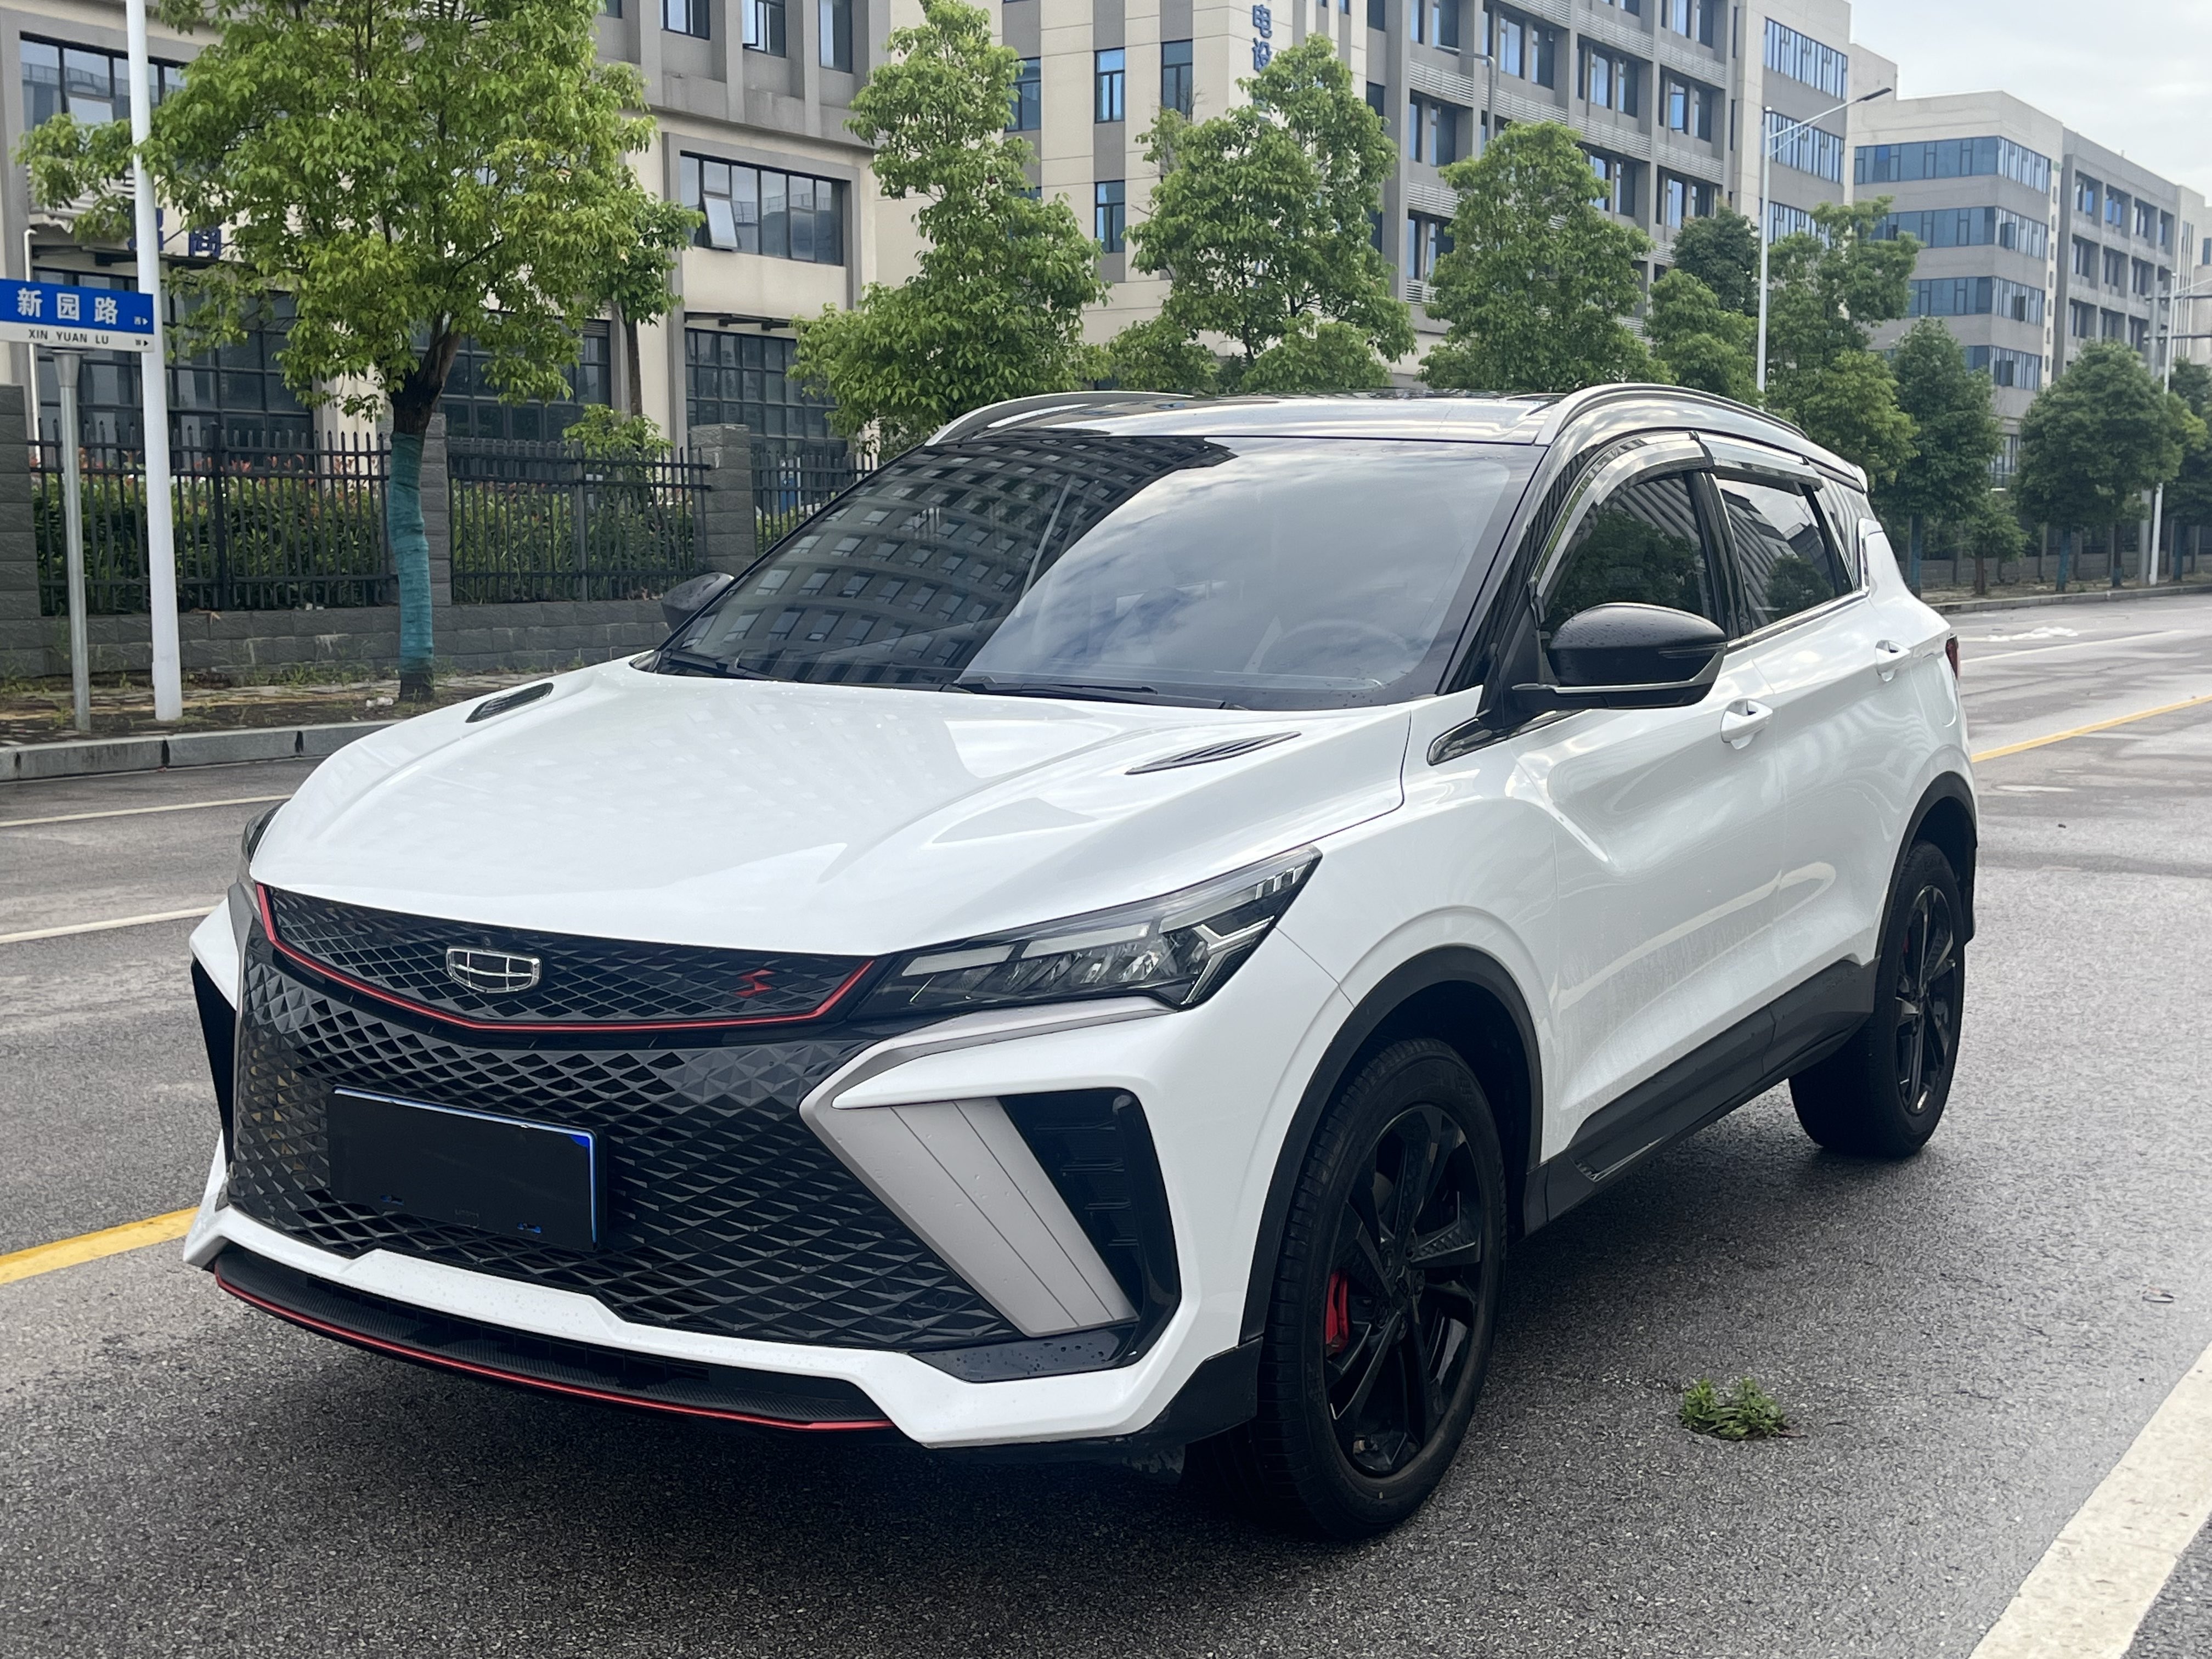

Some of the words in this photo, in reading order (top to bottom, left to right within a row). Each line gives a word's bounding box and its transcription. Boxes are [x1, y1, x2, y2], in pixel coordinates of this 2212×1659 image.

[17, 287, 118, 325] 新园路
[29, 329, 48, 340] XIN
[57, 331, 87, 343] YUAN
[95, 335, 109, 345] LU
